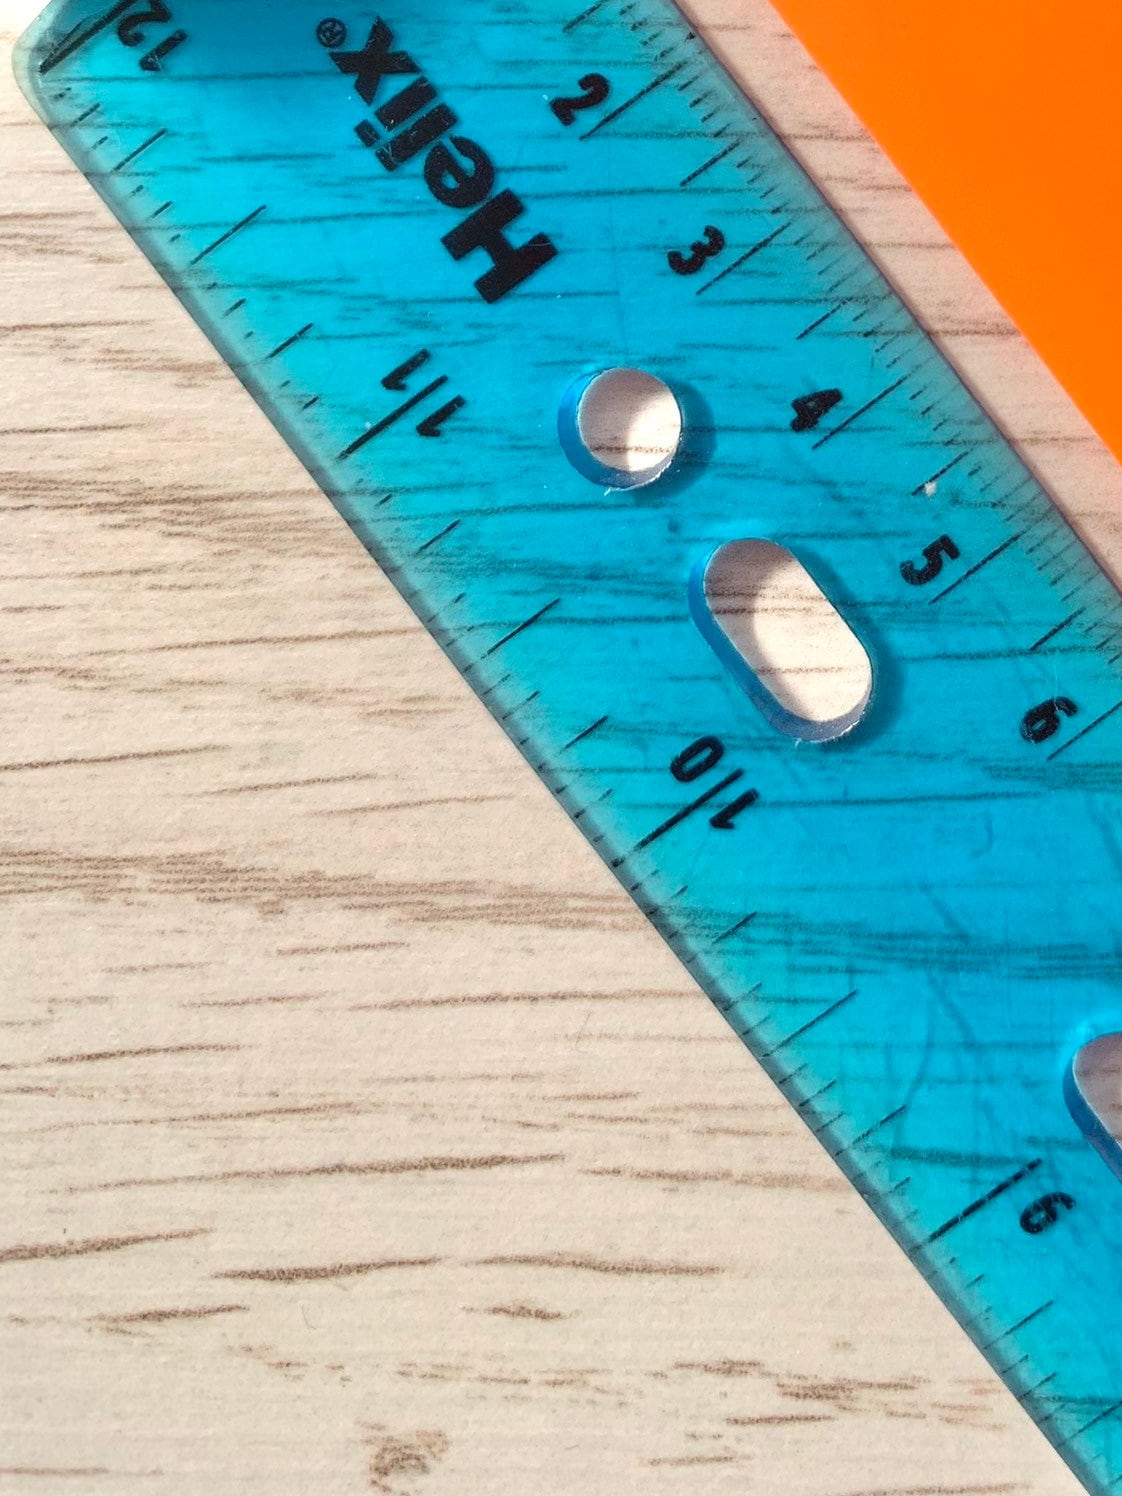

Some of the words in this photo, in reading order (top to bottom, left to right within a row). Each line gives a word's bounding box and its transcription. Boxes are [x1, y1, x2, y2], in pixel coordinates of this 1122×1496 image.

[549, 72, 610, 126] 2
[667, 225, 725, 275] 3
[790, 388, 843, 432] 4
[900, 534, 960, 586] 5
[1019, 695, 1079, 744] 6
